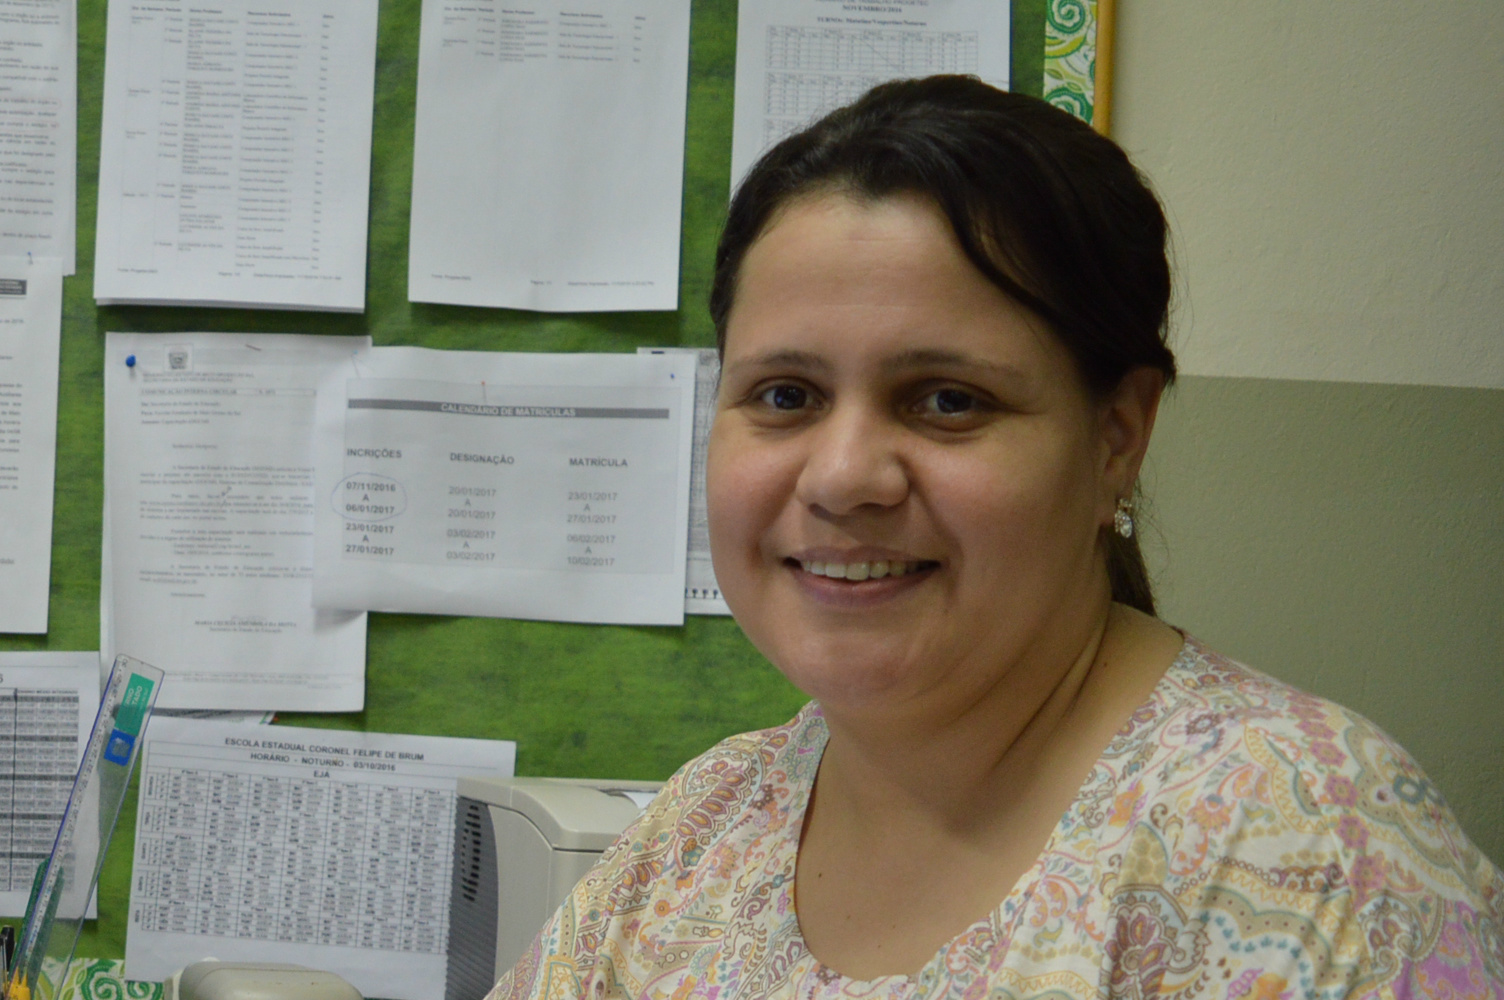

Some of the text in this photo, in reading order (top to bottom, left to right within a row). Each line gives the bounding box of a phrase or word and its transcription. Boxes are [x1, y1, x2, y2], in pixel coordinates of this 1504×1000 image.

[441, 403, 498, 416] CALENDÁRIO
[500, 407, 513, 416] DE
[347, 446, 402, 460] INCRIÇÕES
[450, 452, 515, 466] DESIGNAÇÃO
[569, 455, 628, 468] MATRÍCULA
[347, 482, 396, 492] 07/11/2016
[346, 522, 394, 534] 23/01/2017
[346, 544, 394, 556] 27/01/2017
[225, 737, 425, 761] ESCOLA ESTADUAL CORONEL FELIPE DE BRUM
[250, 751, 290, 763] HORÁRIO
[301, 757, 344, 767] NOTURNO
[313, 770, 330, 779] EJA
